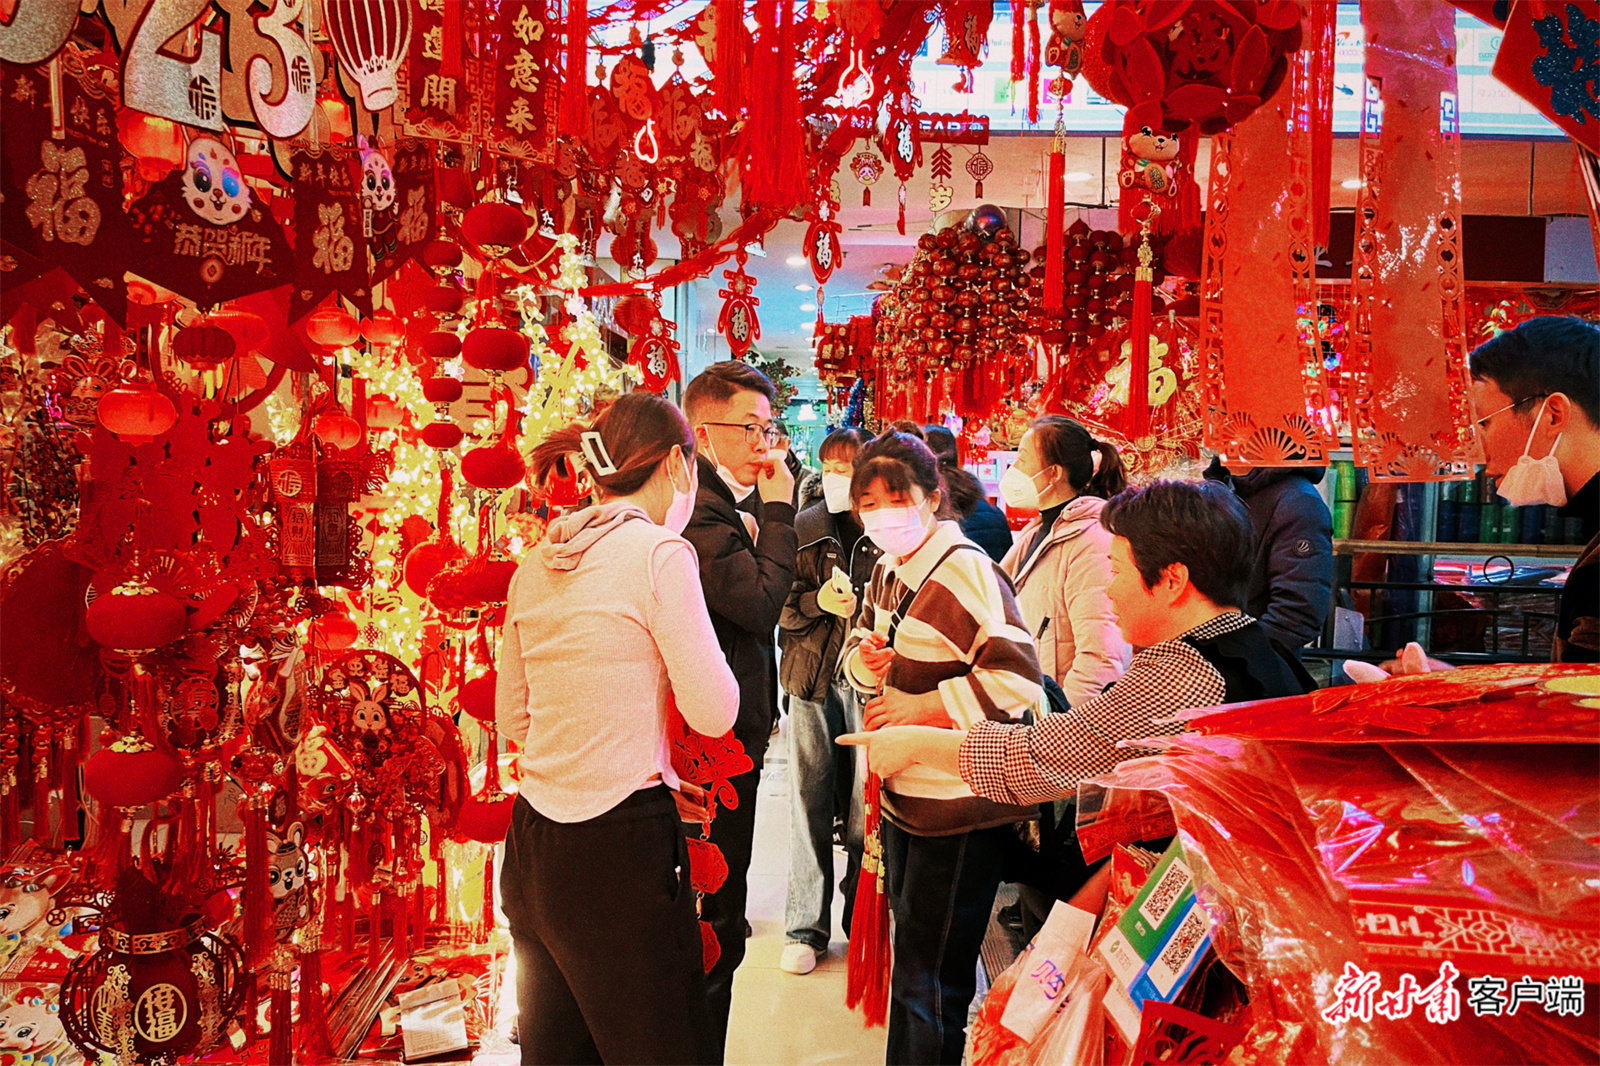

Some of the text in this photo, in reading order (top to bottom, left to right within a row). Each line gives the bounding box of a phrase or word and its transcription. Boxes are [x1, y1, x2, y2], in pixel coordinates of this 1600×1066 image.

[505, 5, 544, 134] 如意来
[188, 75, 217, 120] 福
[25, 139, 102, 247] 福
[173, 222, 274, 276] 恭贺新年
[312, 202, 354, 275] 福
[815, 230, 831, 270] 福
[729, 305, 750, 344] 福
[646, 339, 668, 379] 福
[278, 469, 302, 497] 福
